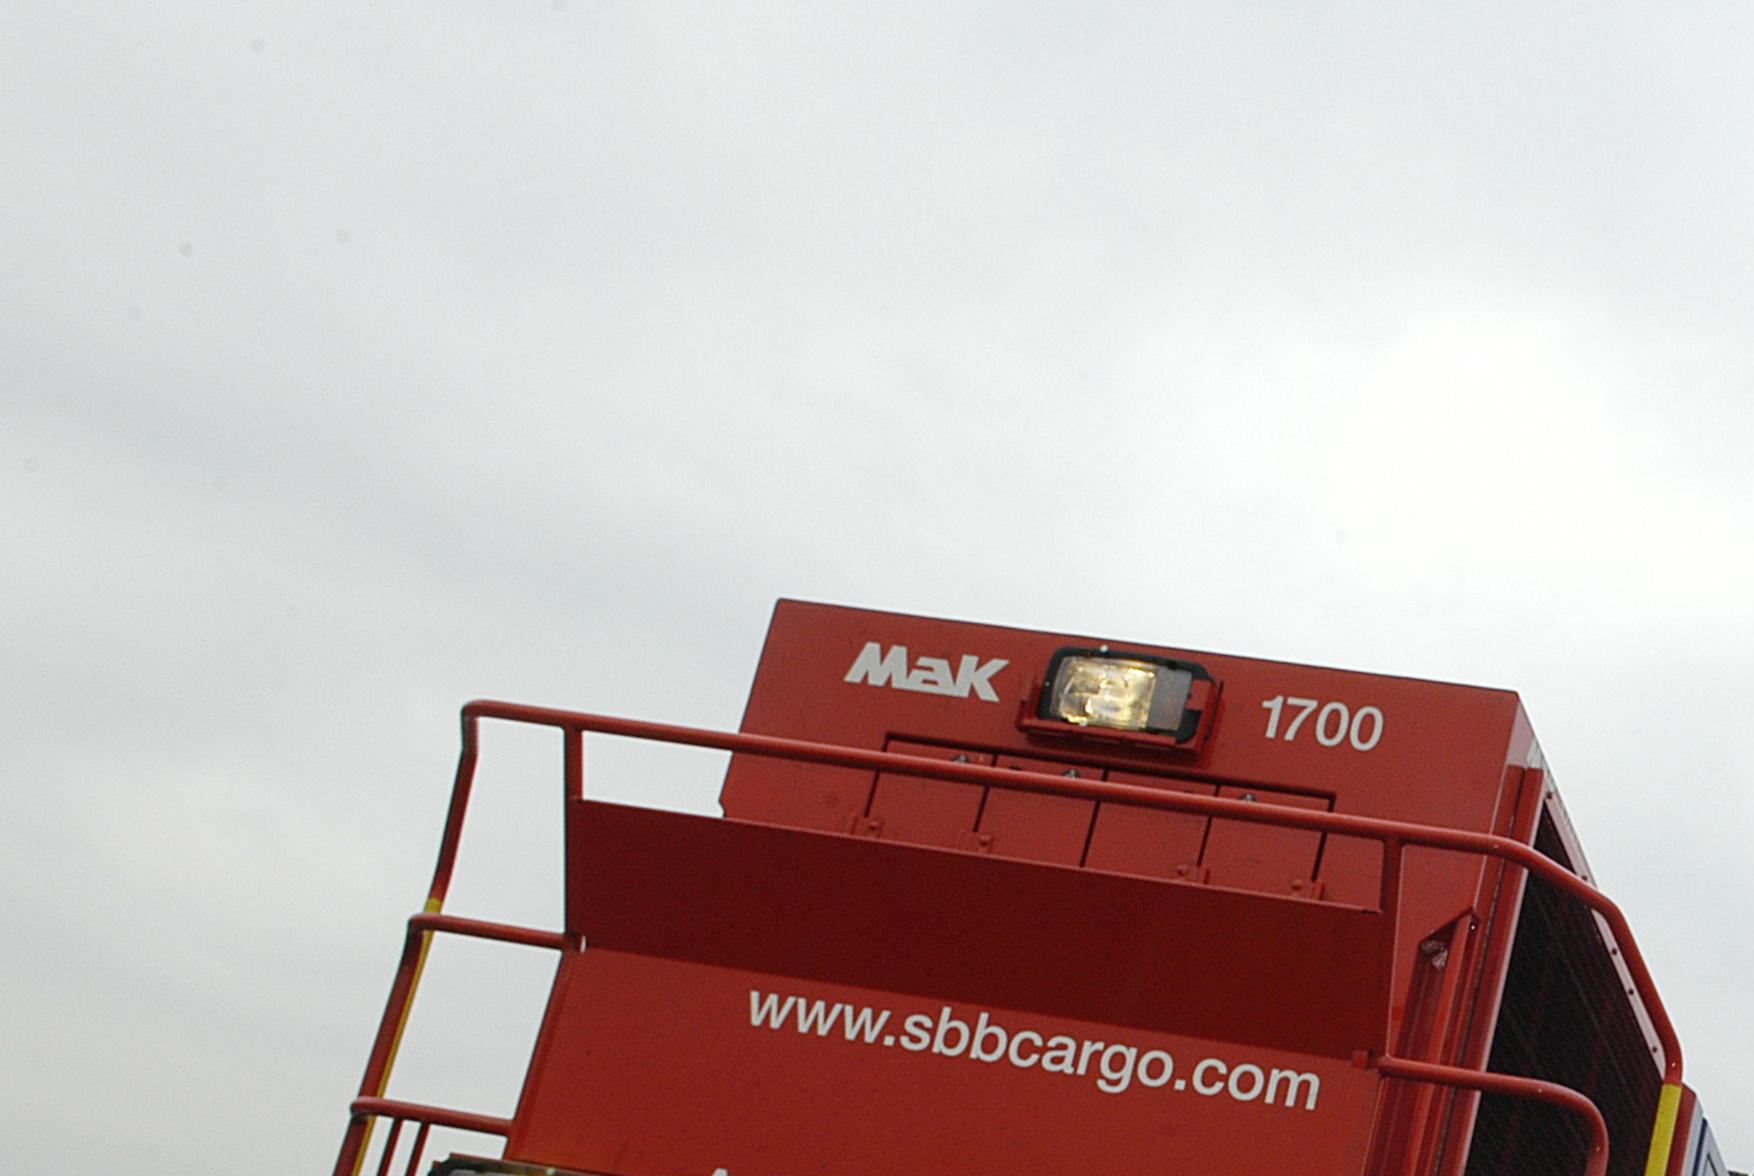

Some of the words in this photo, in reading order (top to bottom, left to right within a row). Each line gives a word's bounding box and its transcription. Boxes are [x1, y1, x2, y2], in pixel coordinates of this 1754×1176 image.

[843, 641, 1010, 703] MaK
[1262, 695, 1384, 751] 1700
[748, 989, 1320, 1112] www.sbbcargo.com
